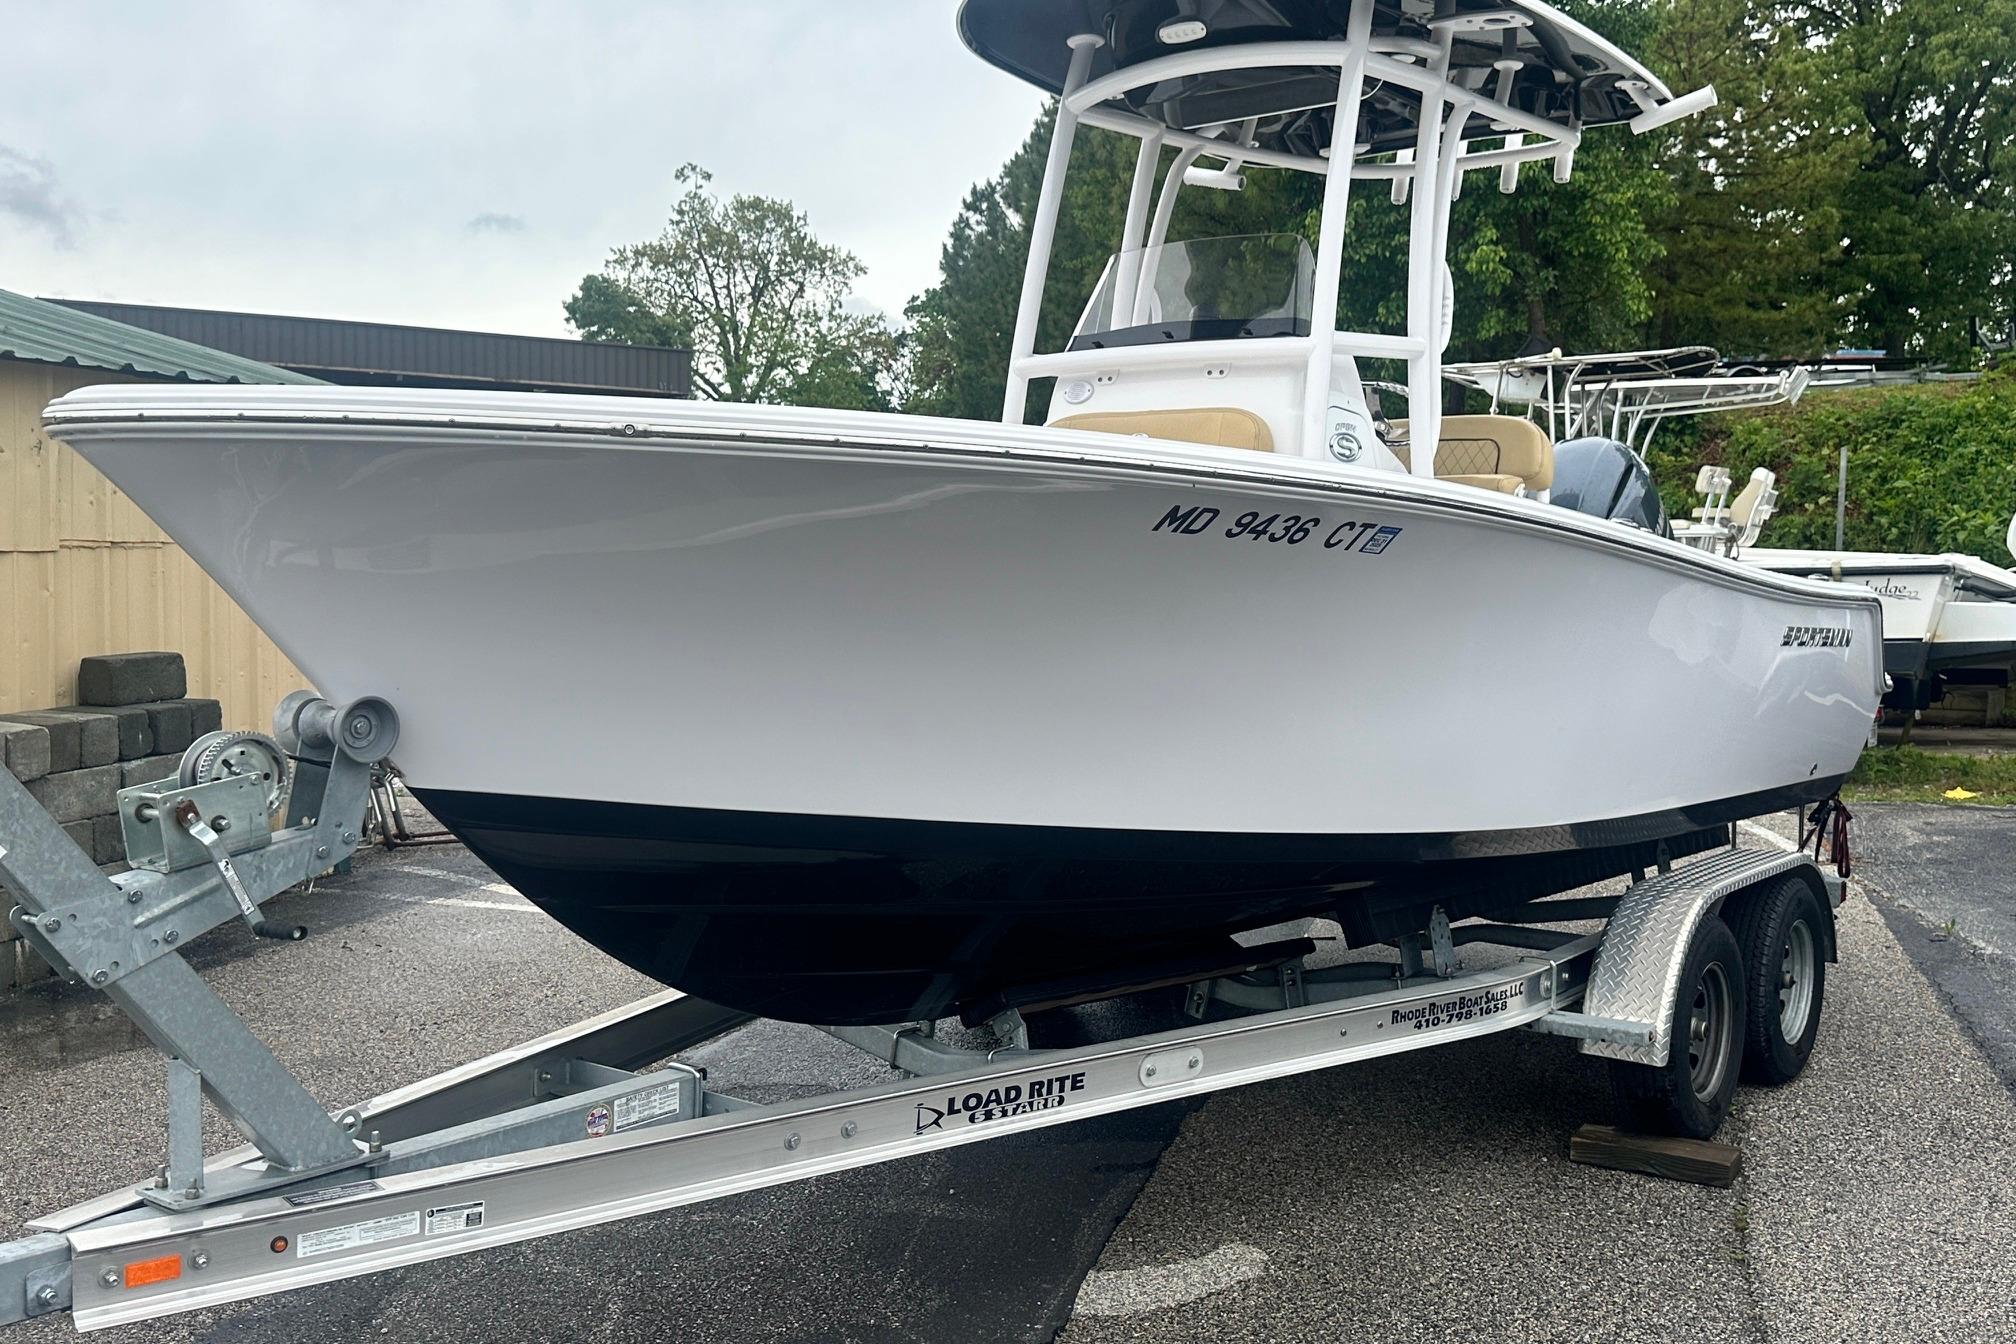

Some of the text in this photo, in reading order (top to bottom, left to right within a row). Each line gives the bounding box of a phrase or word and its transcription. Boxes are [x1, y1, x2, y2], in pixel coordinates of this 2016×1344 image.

[1152, 505, 1220, 534] MD
[1224, 511, 1321, 545] 9436
[1324, 521, 1378, 550] CT
[1780, 626, 1853, 647] SPORTSMAN
[1391, 1008, 1427, 1025] RHODE
[1428, 1002, 1458, 1017] RIVER
[1458, 995, 1484, 1012] BOAT
[1509, 981, 1524, 998] LLC
[1413, 1000, 1508, 1031] 410-798-1658
[946, 1071, 1086, 1117] LOAD RITE
